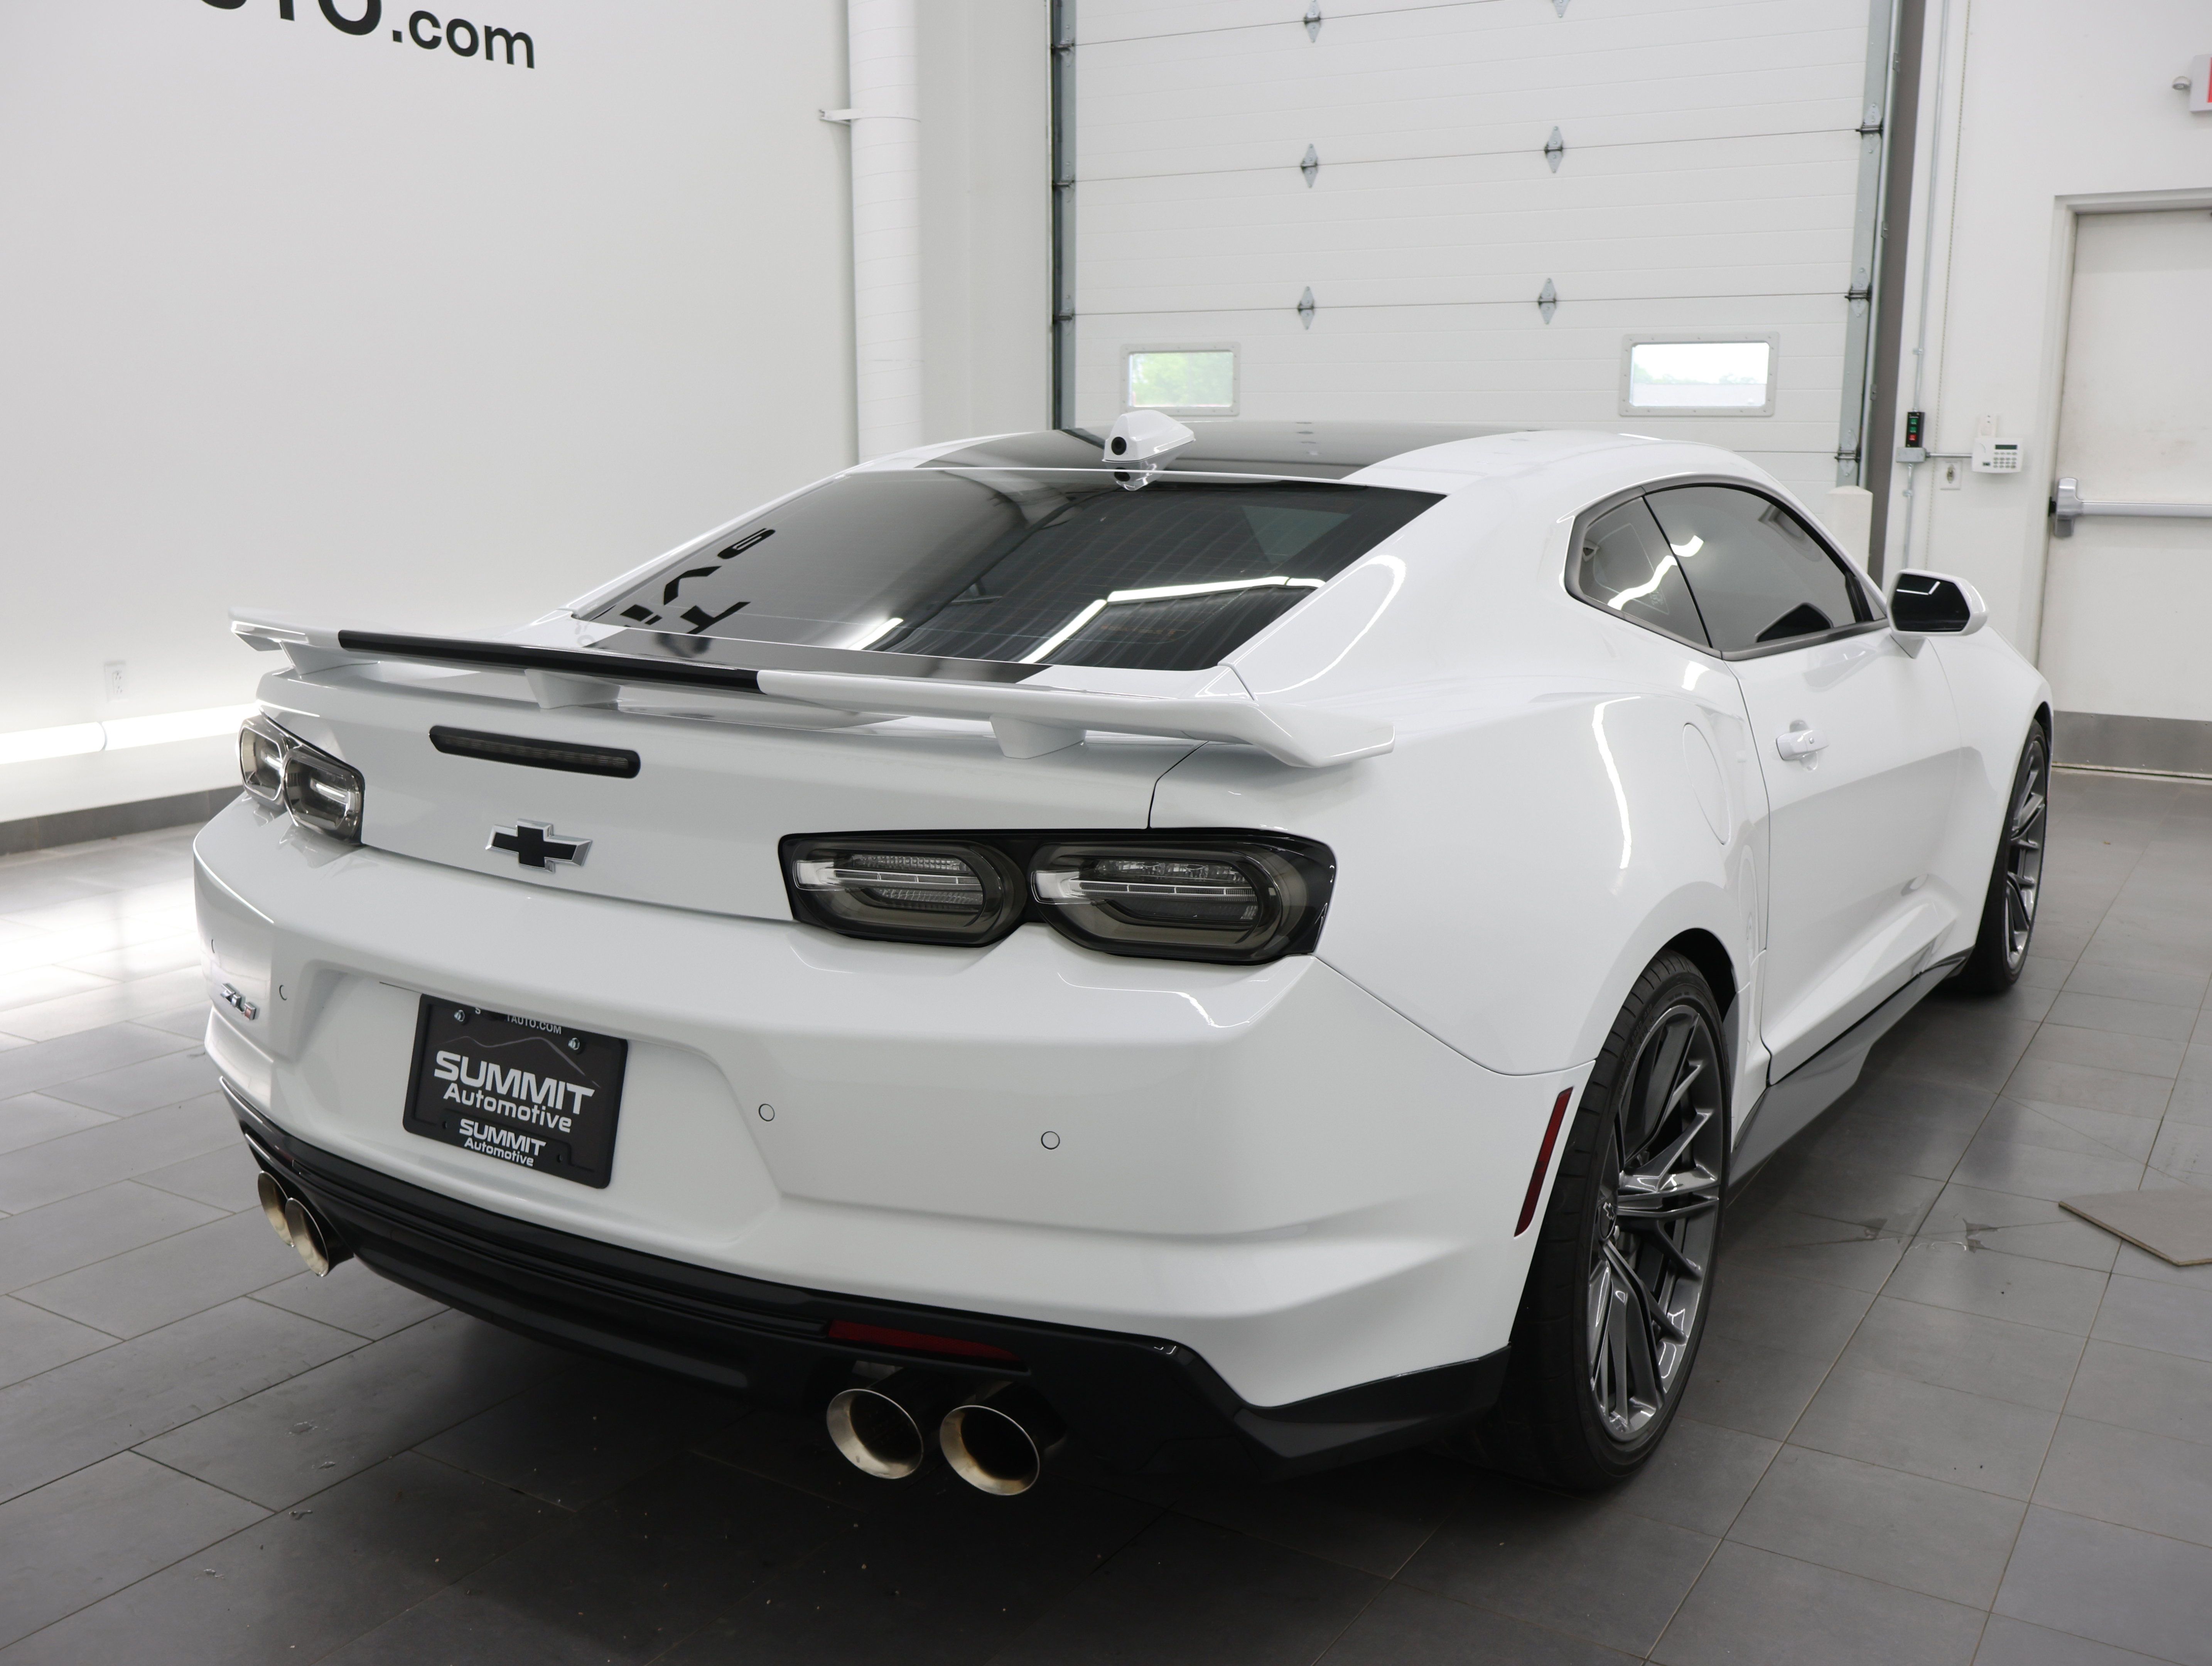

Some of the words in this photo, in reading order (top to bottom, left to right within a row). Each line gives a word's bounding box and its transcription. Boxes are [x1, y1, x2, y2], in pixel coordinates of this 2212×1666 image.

[434, 1051, 595, 1115] SUMMIT
[443, 1083, 572, 1133] Automotive
[459, 1118, 547, 1156] SUMMIT
[464, 1137, 534, 1167] Automotive
